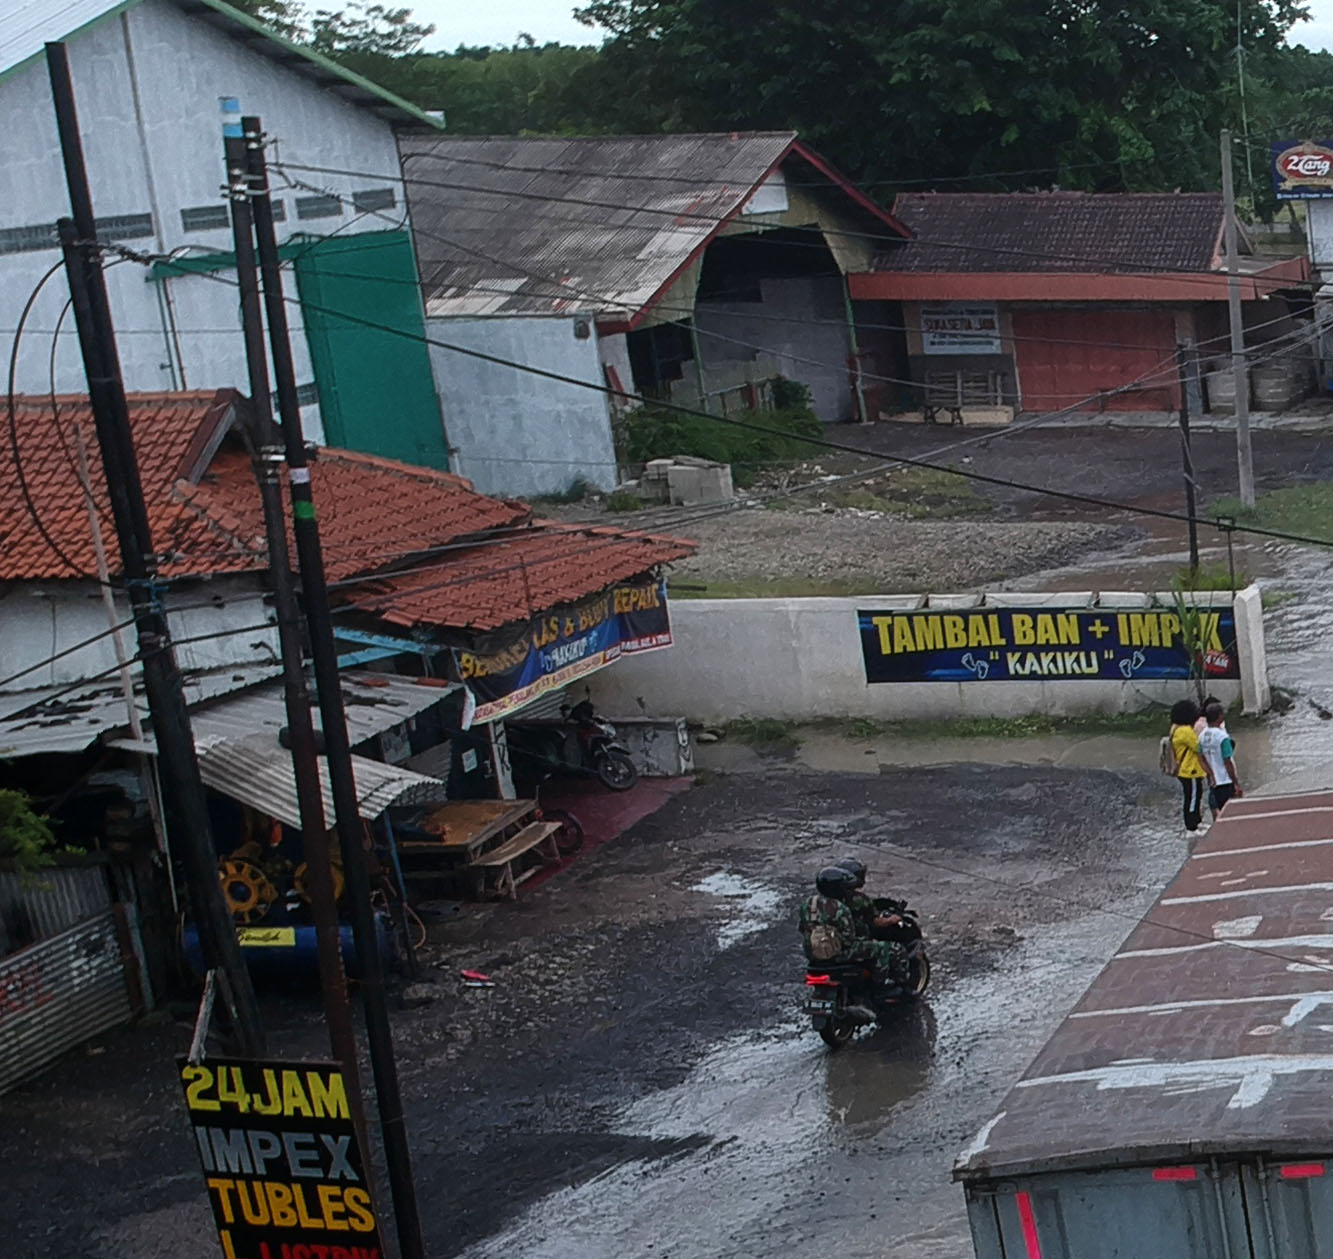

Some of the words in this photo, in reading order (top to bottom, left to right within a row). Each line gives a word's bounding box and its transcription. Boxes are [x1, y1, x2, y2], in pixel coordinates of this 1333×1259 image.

[872, 614, 1006, 655] TAMBAL
[1012, 613, 1080, 645] BAN
[1117, 612, 1224, 652] IMPK
[195, 1125, 360, 1182] IMPEX
[208, 1178, 376, 1232] TUBLES
